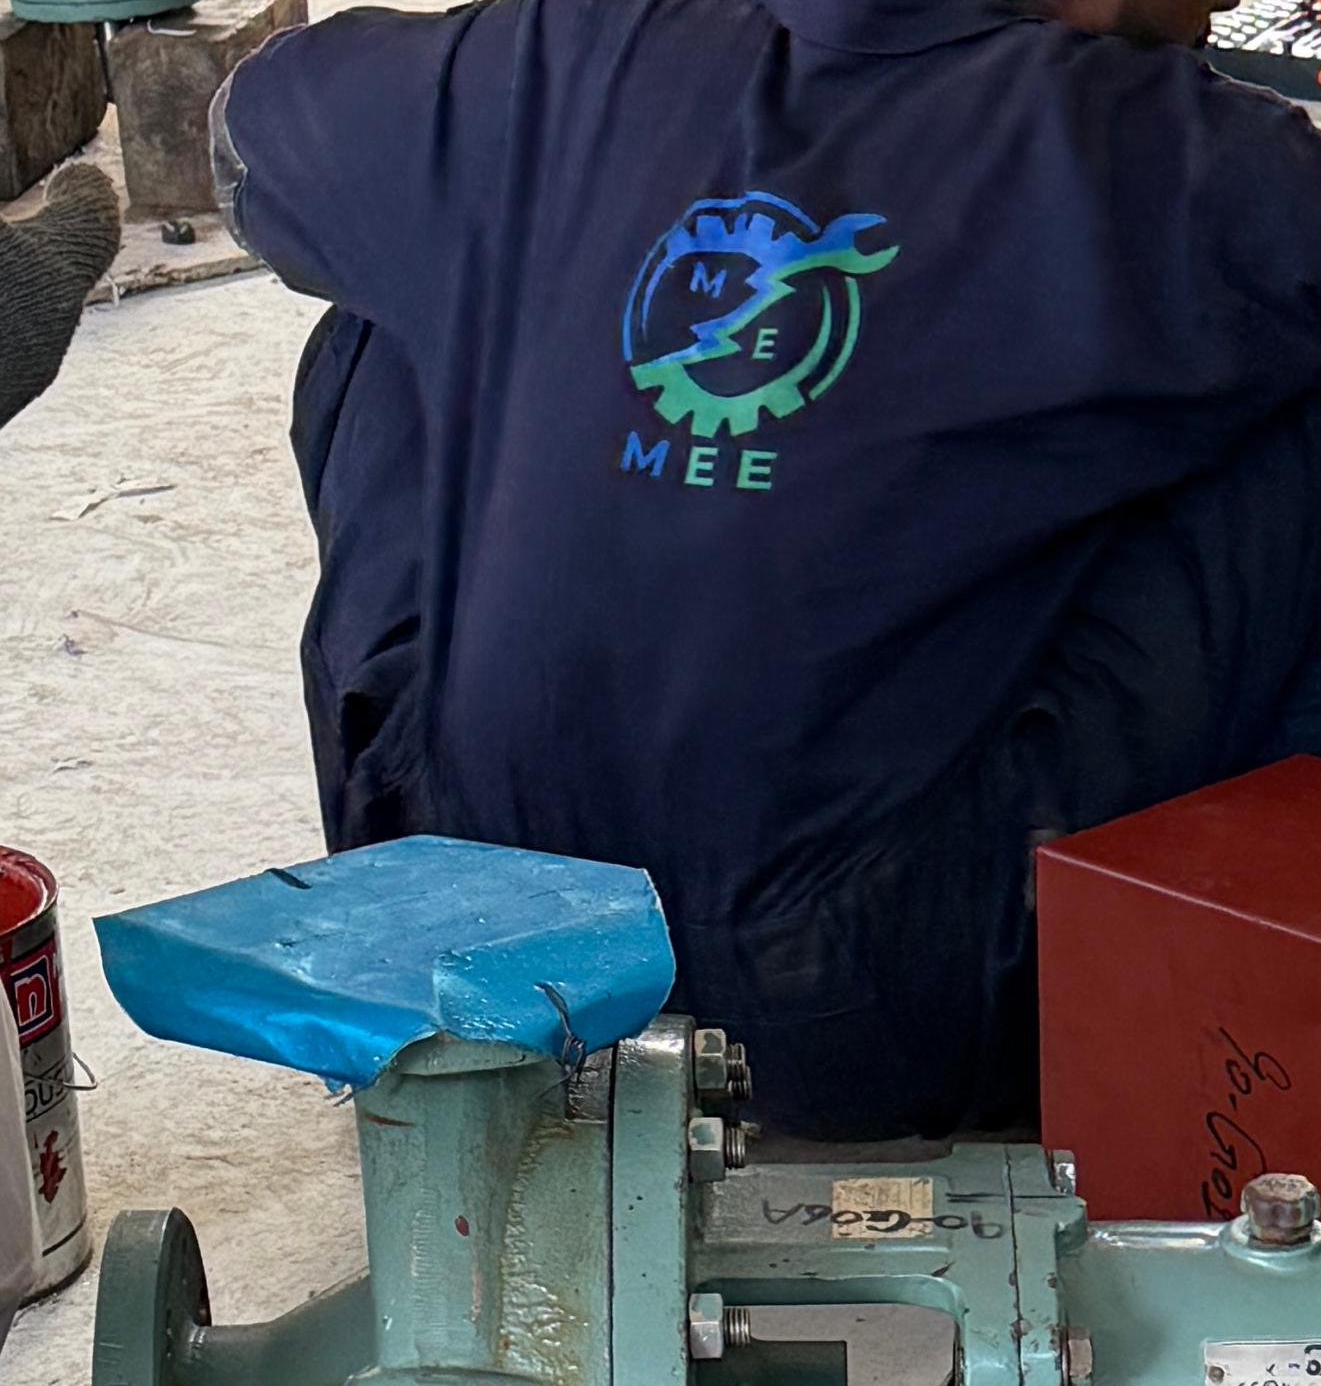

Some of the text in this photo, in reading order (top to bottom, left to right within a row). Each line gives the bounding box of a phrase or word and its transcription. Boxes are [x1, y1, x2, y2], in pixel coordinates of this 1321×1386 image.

[690, 261, 727, 298] M
[752, 329, 778, 359] E
[620, 430, 777, 490] MEE
